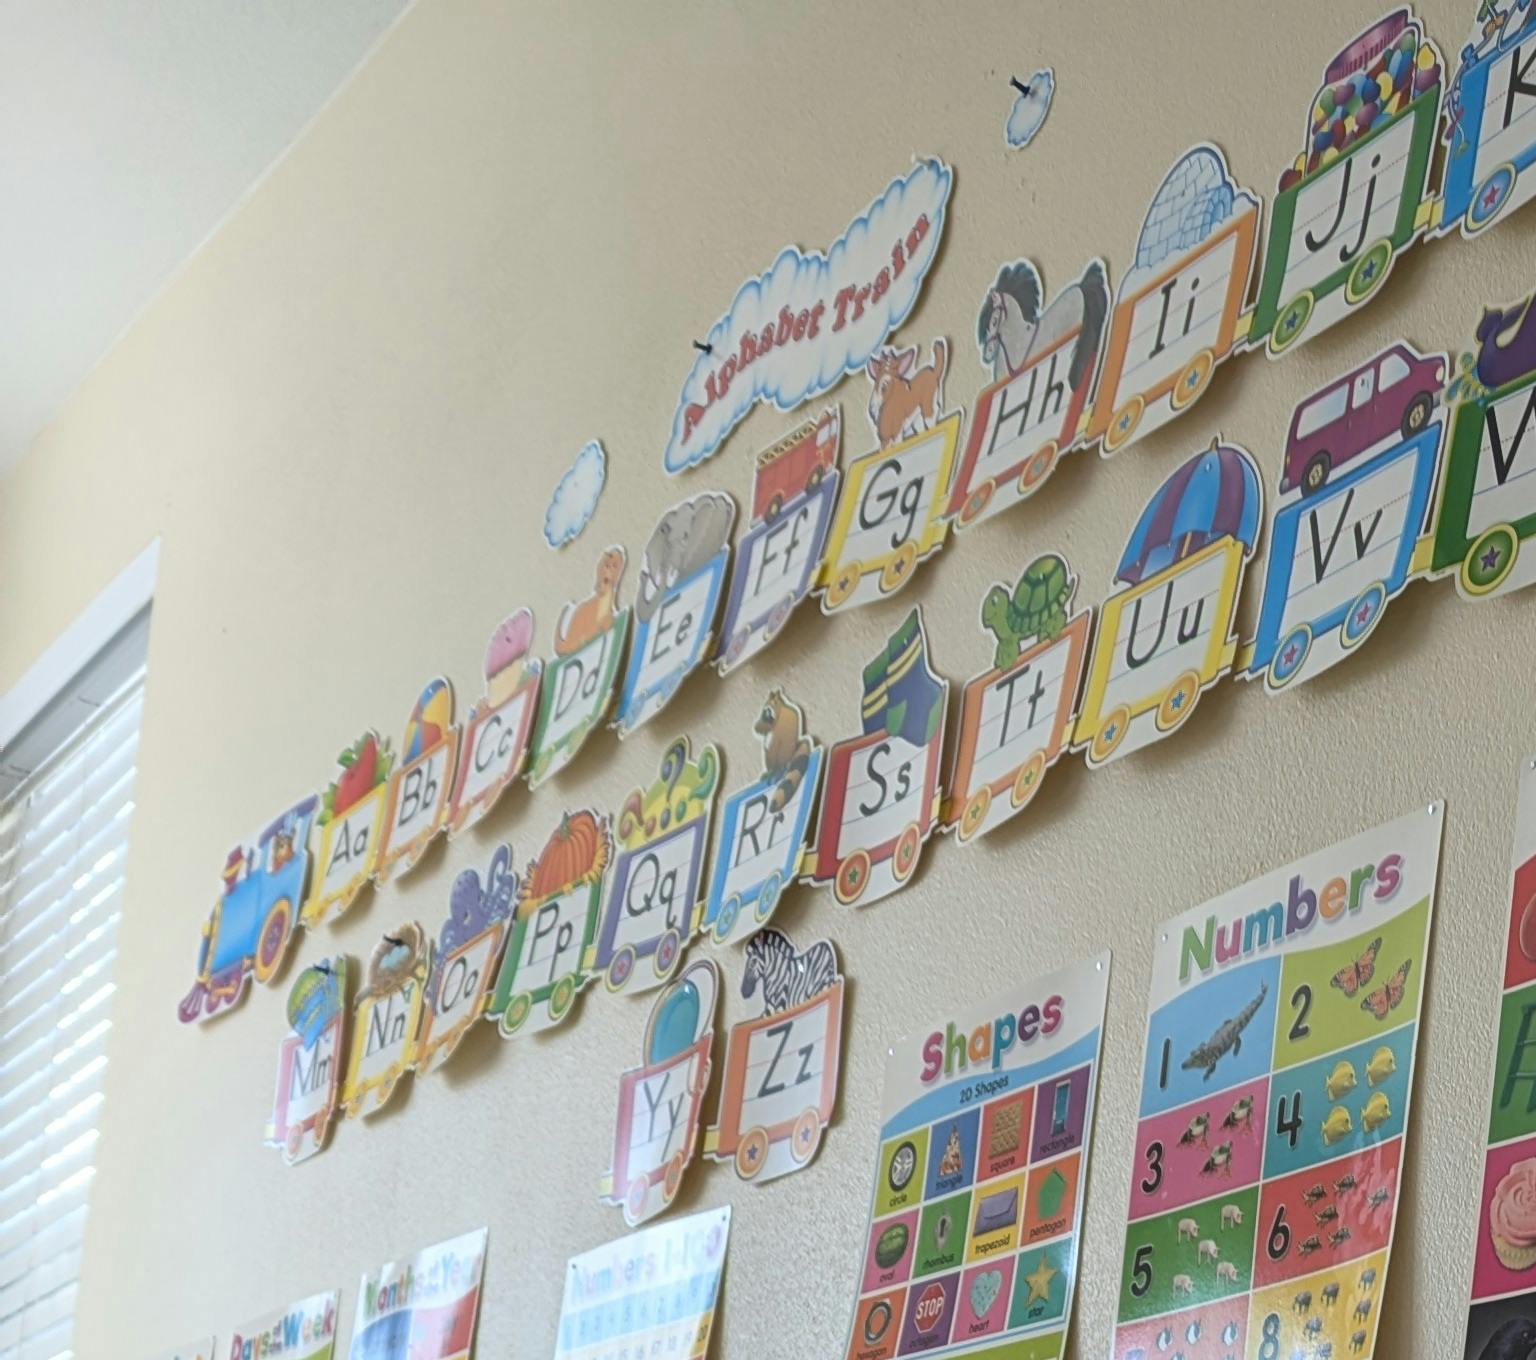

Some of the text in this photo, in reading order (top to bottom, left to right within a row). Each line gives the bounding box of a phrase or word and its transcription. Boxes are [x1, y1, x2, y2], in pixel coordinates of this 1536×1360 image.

[1305, 154, 1382, 262] Jj
[681, 213, 930, 446] Alphabet Train
[1149, 277, 1199, 359] Ii
[987, 358, 1063, 456] Hh
[860, 460, 923, 548] Gg
[1309, 488, 1382, 584] Vv
[754, 508, 810, 595] Ff
[649, 594, 693, 662] Ee
[1127, 581, 1203, 669] Uu
[554, 637, 607, 719] Dd
[995, 665, 1045, 746] Tt
[475, 716, 513, 773] Cc
[859, 744, 911, 817] Ss
[400, 770, 437, 828] Bb
[735, 795, 784, 867] Rr
[327, 818, 370, 876] Aa
[627, 853, 678, 930] Qq
[1179, 854, 1402, 983] Numbers
[527, 903, 573, 980] Pp
[441, 955, 478, 1013] Oo
[1289, 984, 1312, 1041] 2
[366, 992, 406, 1058] Nn
[757, 1022, 813, 1098] Zz
[920, 995, 1064, 1083] Shapes
[974, 1076, 1009, 1098] Shapes
[1160, 1038, 1171, 1089] 1
[642, 1074, 683, 1161] Yy
[1277, 1091, 1302, 1147] 4
[1141, 1142, 1163, 1193] 3
[1267, 1206, 1290, 1259] 6
[1130, 1245, 1153, 1297] 5
[283, 1309, 334, 1346] Week
[917, 1297, 944, 1319] STOP
[969, 1321, 989, 1334] heart
